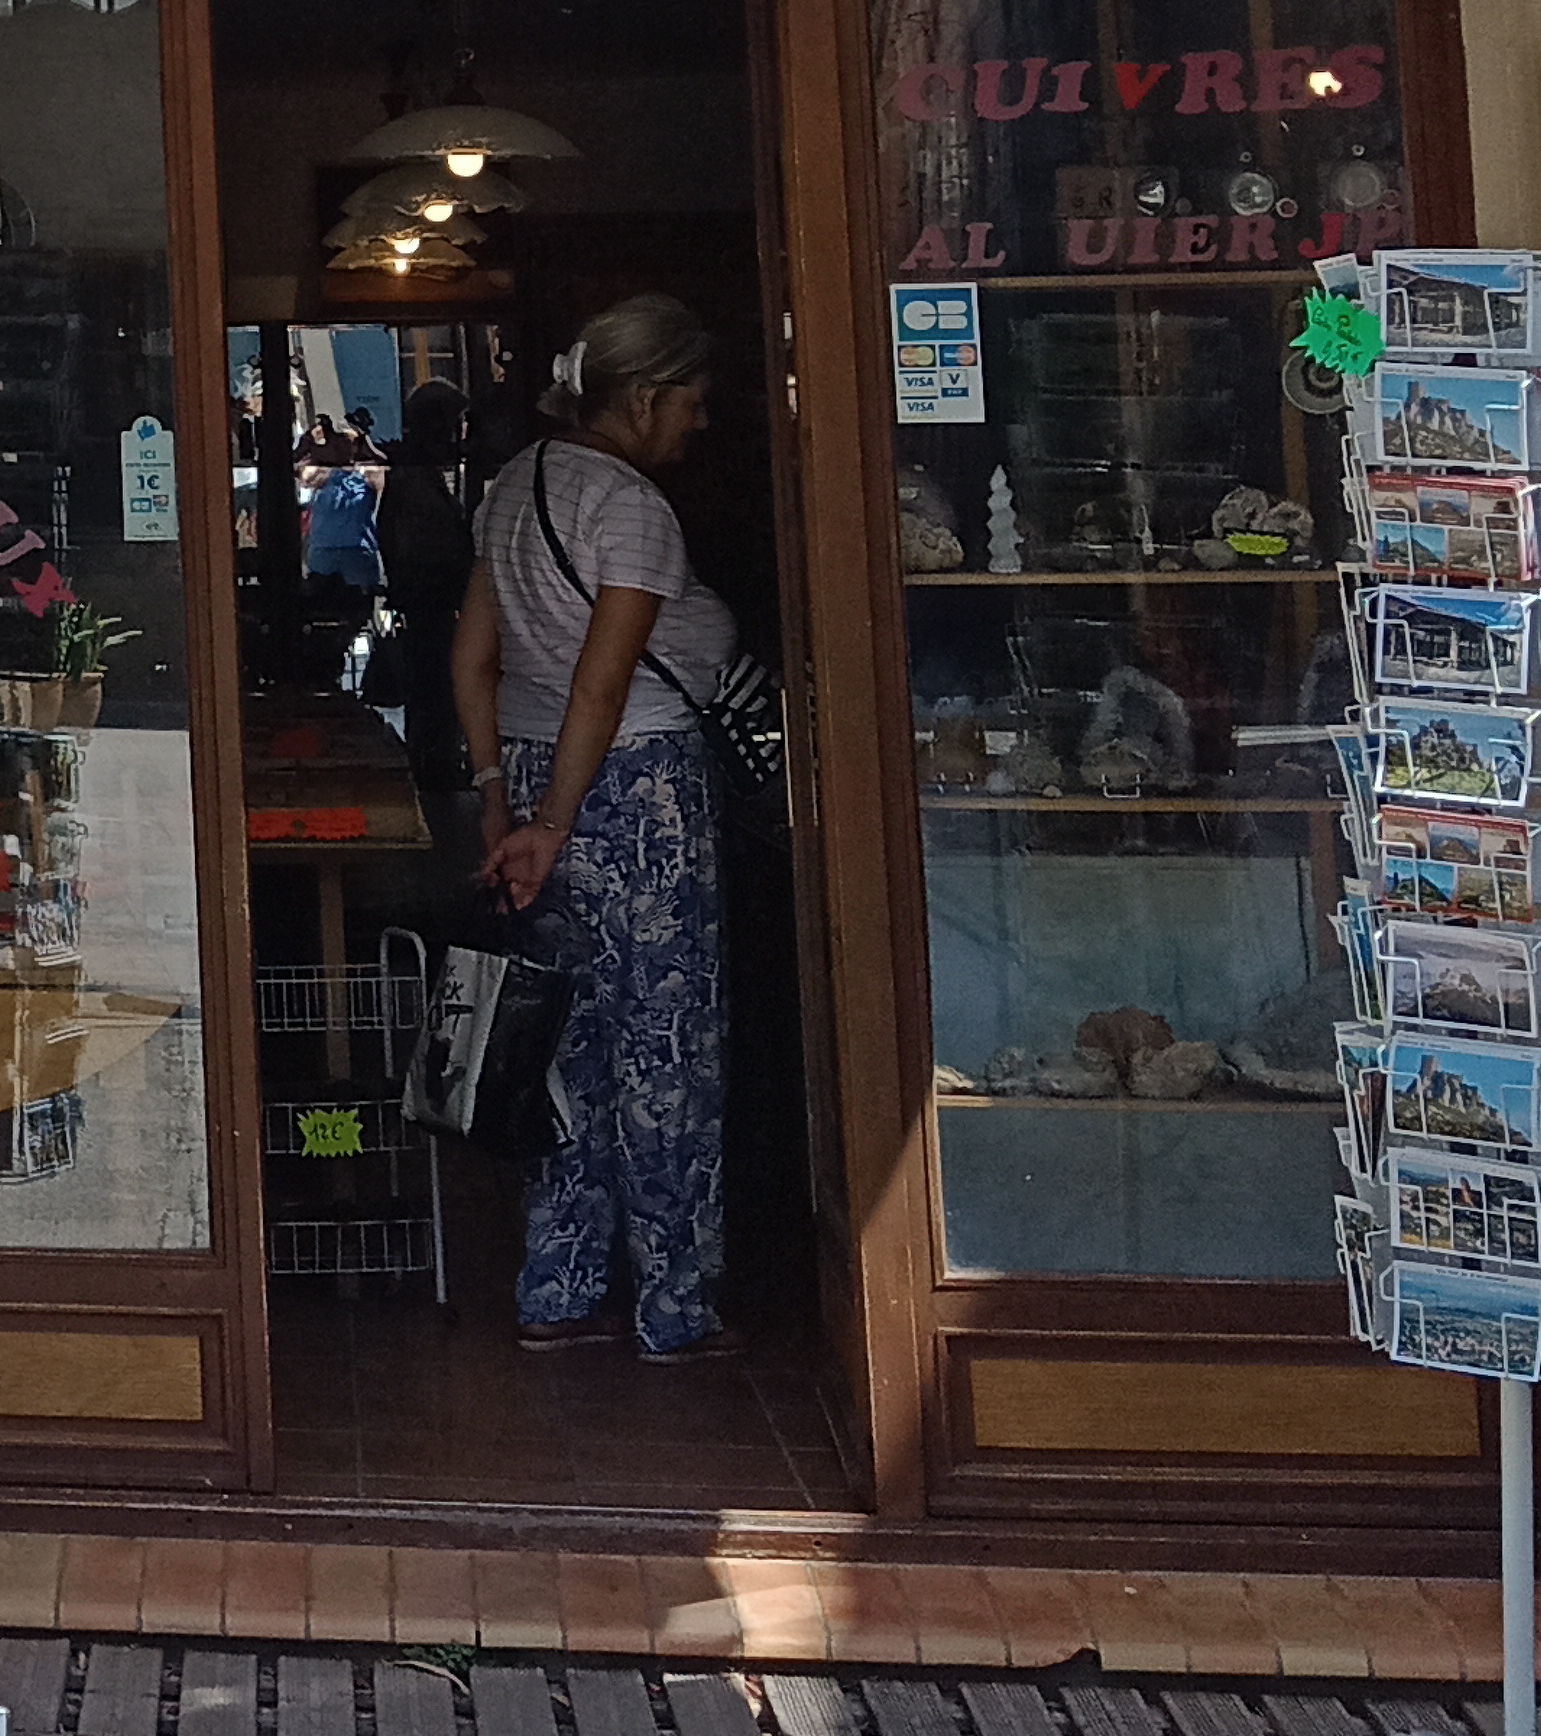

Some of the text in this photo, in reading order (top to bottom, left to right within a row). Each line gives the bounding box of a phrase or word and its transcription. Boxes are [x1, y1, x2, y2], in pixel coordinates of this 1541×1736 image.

[895, 45, 1384, 121] CUIVRES
[904, 377, 935, 387] VISA
[907, 402, 935, 412] VISA
[139, 450, 157, 460] ICI
[136, 474, 160, 490] 1€
